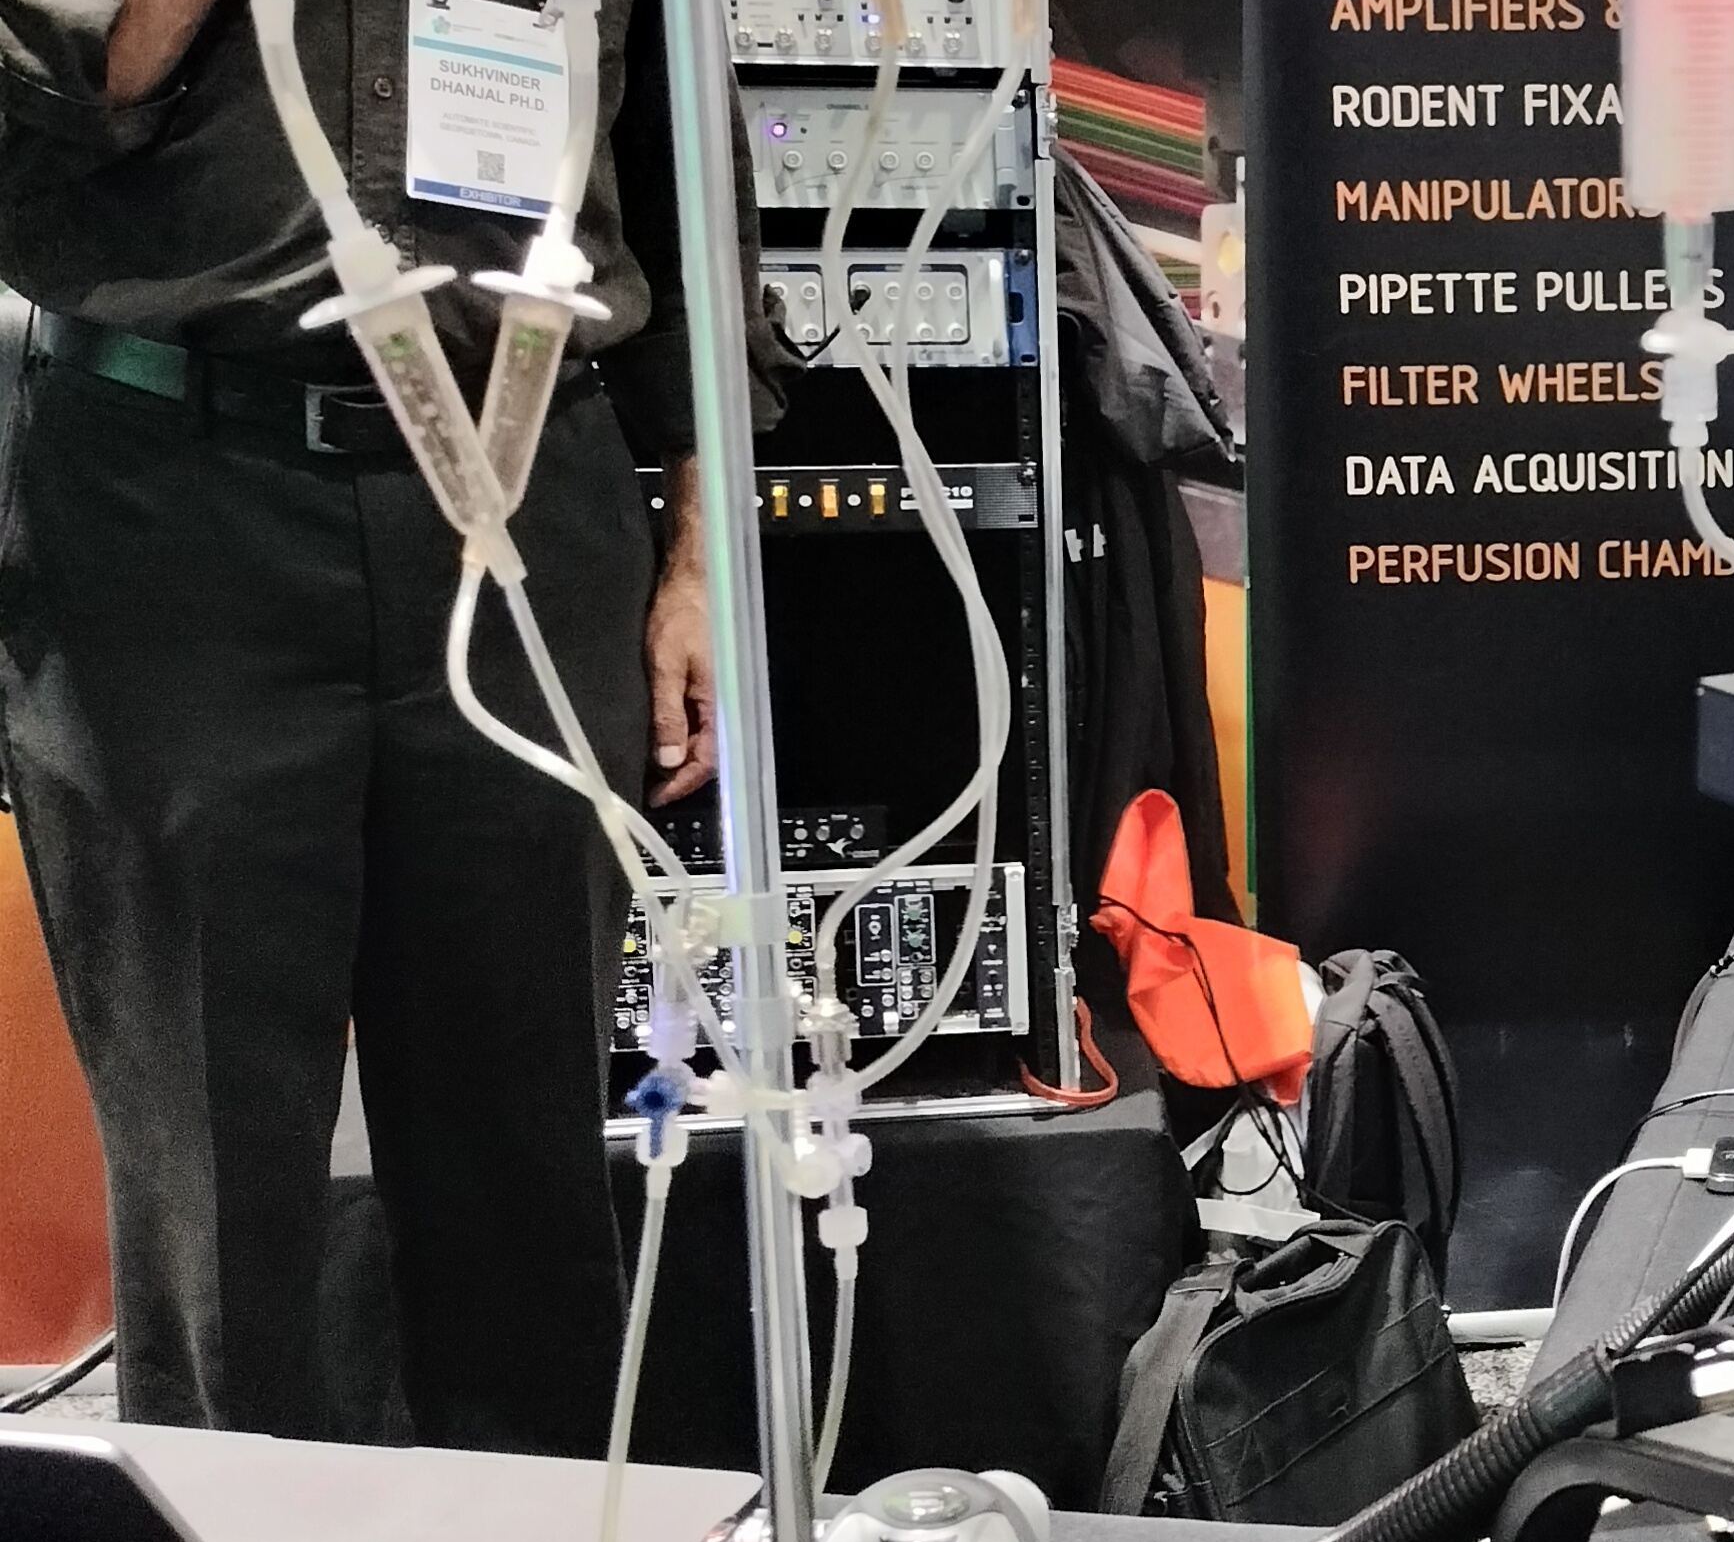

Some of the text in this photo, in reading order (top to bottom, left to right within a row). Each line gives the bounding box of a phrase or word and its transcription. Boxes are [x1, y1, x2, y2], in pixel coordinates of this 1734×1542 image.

[430, 77, 548, 112] DHANJAL PH.D.
[439, 59, 541, 91] SUKHVINDER
[1333, 83, 1625, 128] RODENT FIXA
[459, 187, 522, 208] EXHIBITOR
[1339, 272, 1518, 315] PIPETTE
[1342, 360, 1667, 406] FILTER WHEELS
[1346, 455, 1455, 496] DATA
[1349, 543, 1581, 584] PERFUSION
